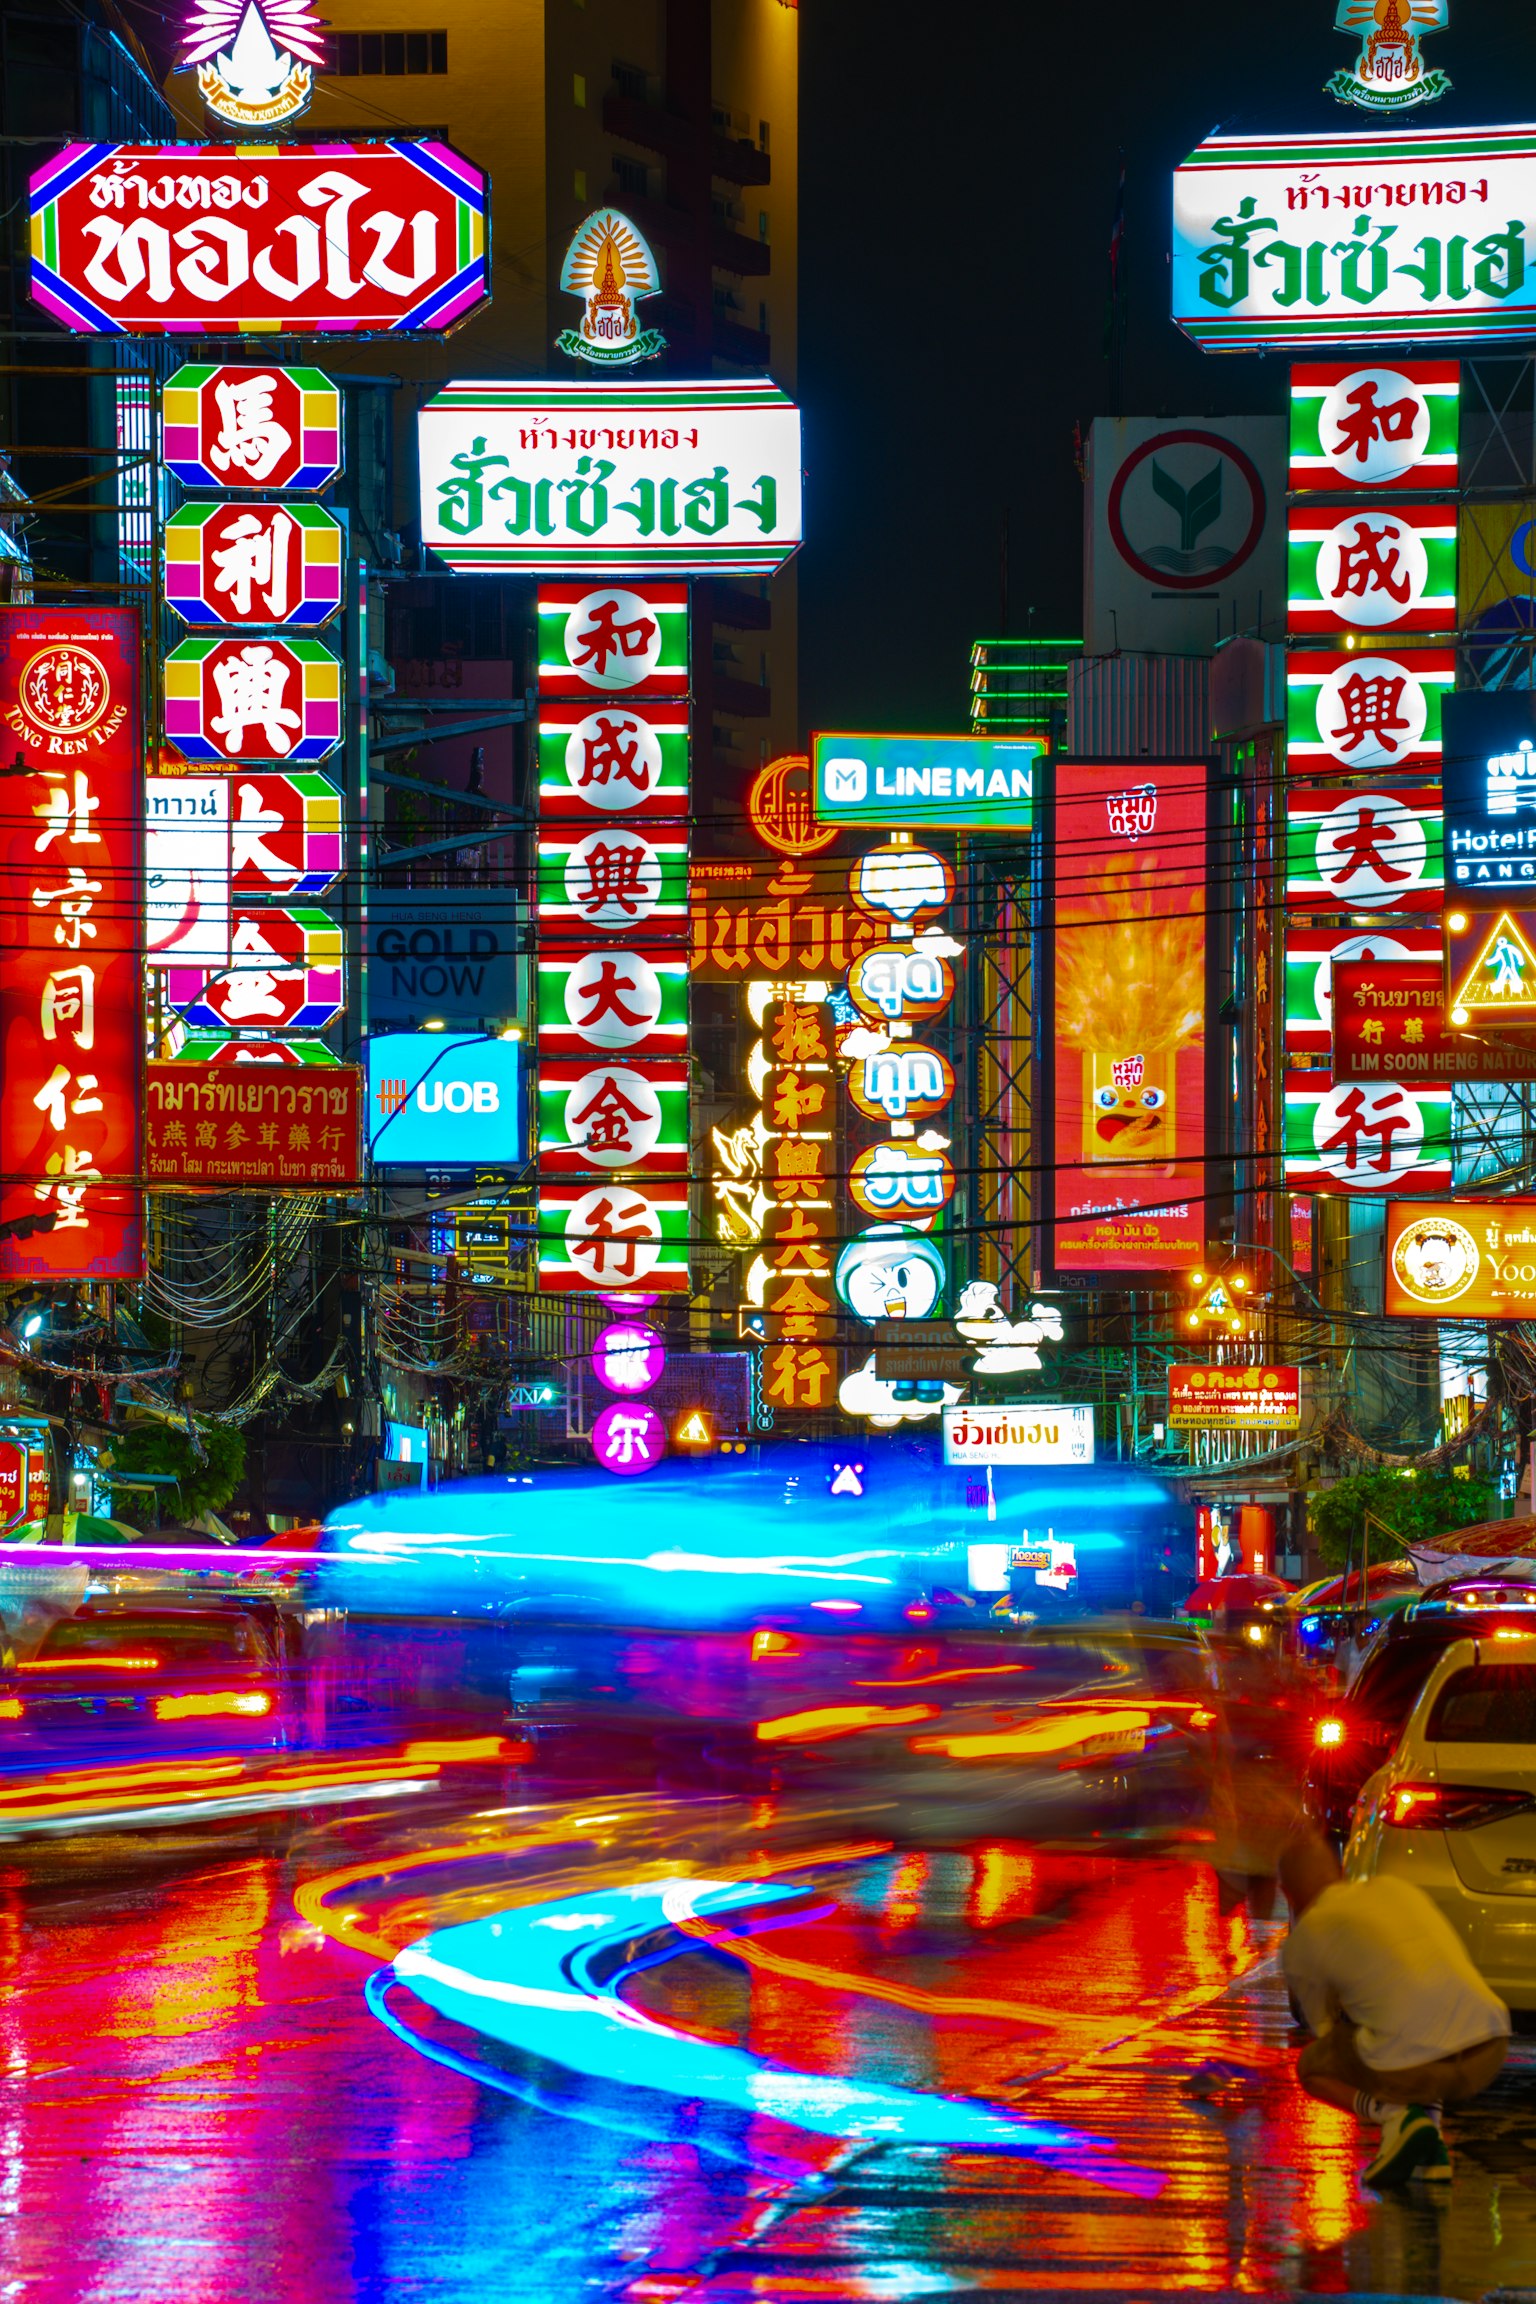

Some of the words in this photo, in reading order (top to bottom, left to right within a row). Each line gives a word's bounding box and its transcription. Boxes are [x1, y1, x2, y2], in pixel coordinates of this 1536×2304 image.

[88, 161, 270, 210] ห้างทอง
[1285, 173, 1489, 211] ห้างขายทอง
[82, 170, 440, 303] ทองใบ
[1197, 196, 1536, 309] ฮั่วเซ่งเฮ
[519, 416, 699, 451] ห้างขายทอง
[437, 435, 778, 537] ฮั่วเซ่งเฮง
[53, 660, 76, 727] 同仁堂
[3, 703, 44, 748] TONG
[46, 734, 89, 755] REN
[87, 704, 128, 746] TANG
[209, 373, 306, 1062] 馬利興大金
[875, 766, 952, 797] LINE
[955, 767, 1033, 798] MAN
[1321, 380, 1420, 1174] 和成興大行
[1456, 863, 1535, 879] BANG
[391, 911, 414, 921] HUA
[418, 911, 448, 921] SENG
[451, 911, 482, 921] HENG
[376, 928, 499, 964] GOLD
[32, 769, 104, 1230] 北京同仁堂
[391, 965, 486, 998] NOW
[1351, 1053, 1380, 1072] LIM
[1383, 1053, 1429, 1072] SOON
[1433, 1052, 1478, 1071] HENG
[416, 1080, 500, 1114] UOB
[1059, 1275, 1086, 1287] Plan
[952, 1451, 968, 1460] HUA
